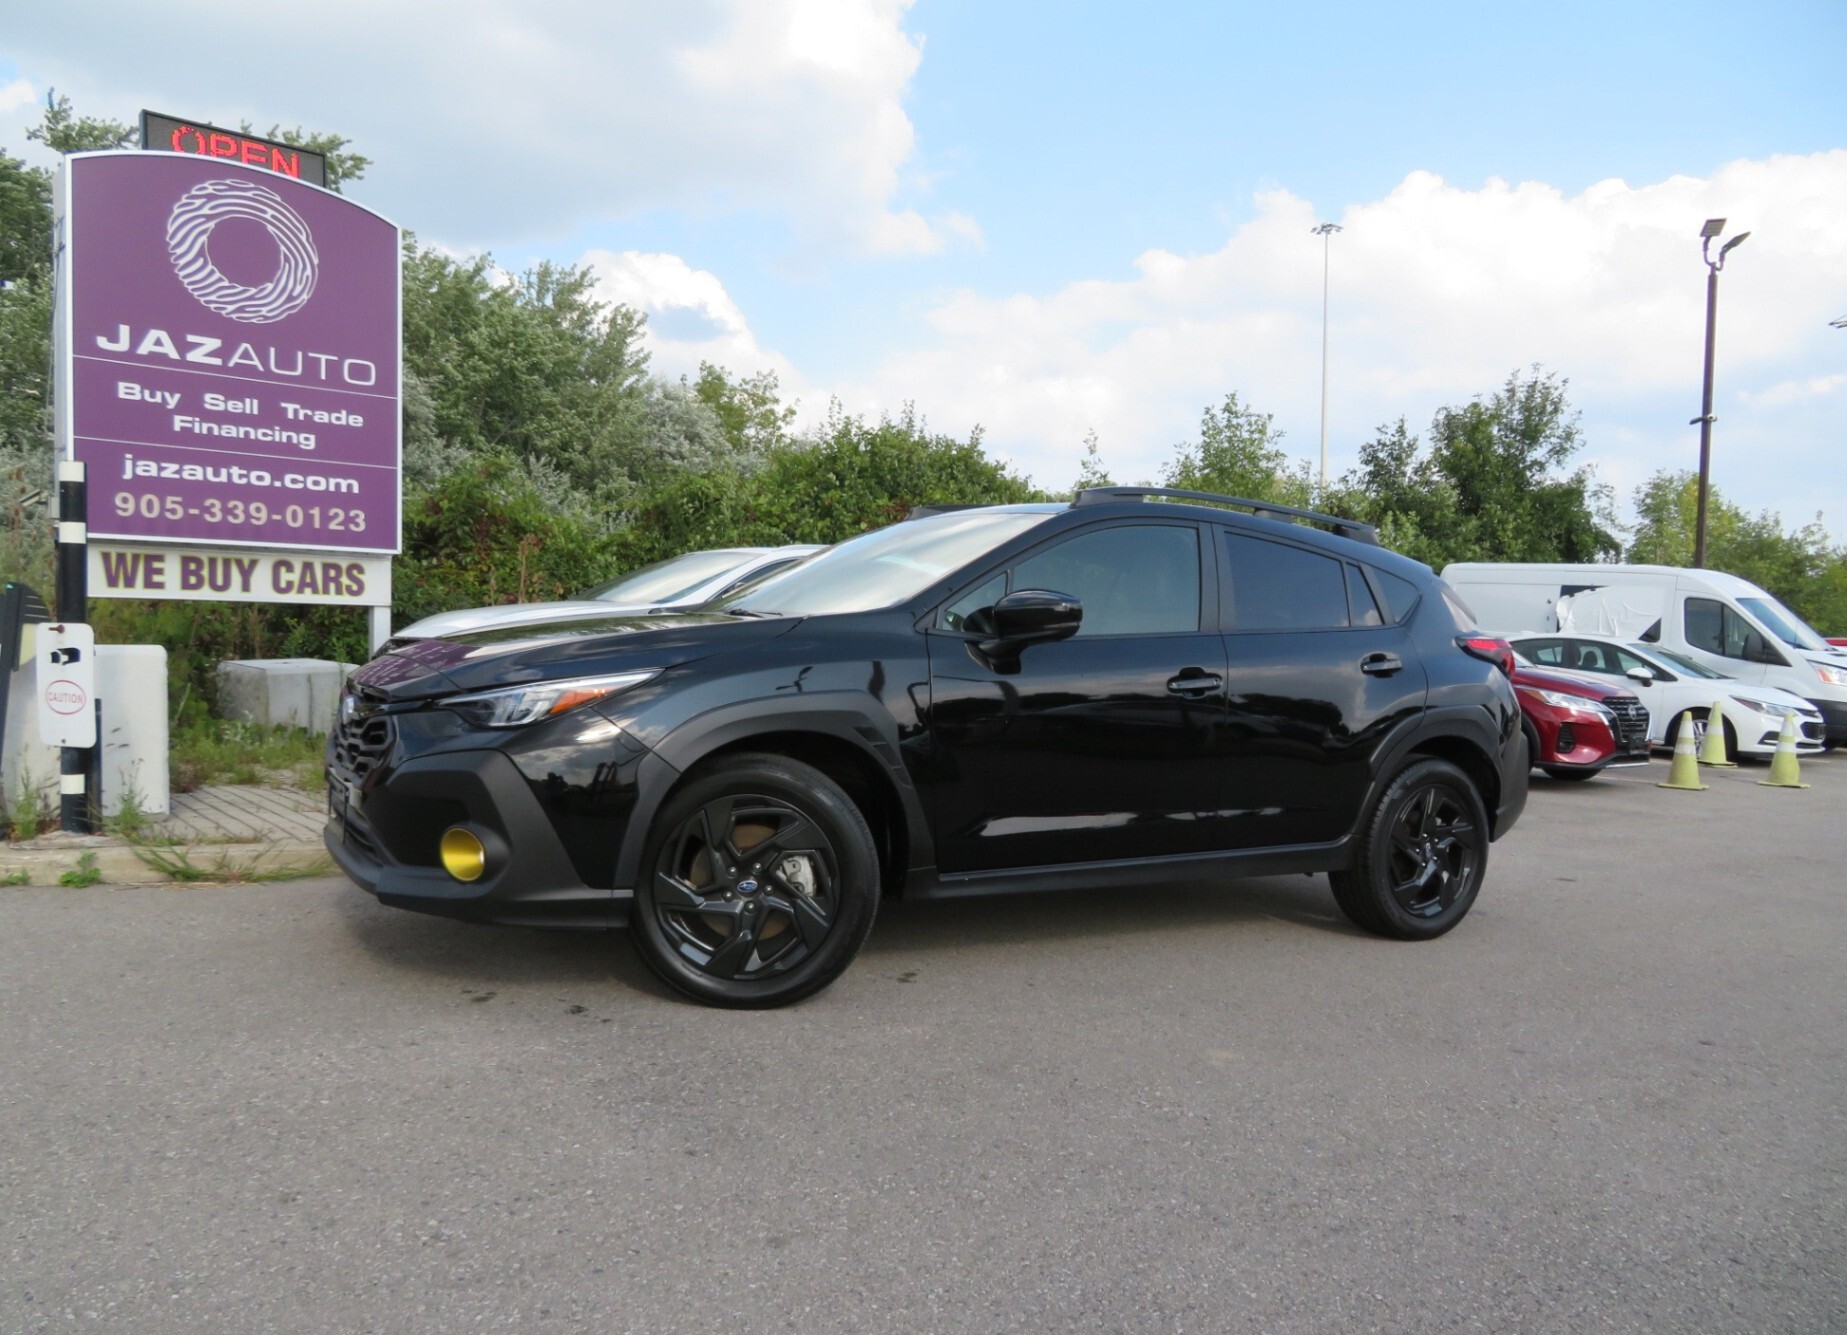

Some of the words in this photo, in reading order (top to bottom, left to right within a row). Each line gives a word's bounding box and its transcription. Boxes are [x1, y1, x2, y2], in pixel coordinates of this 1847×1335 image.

[171, 126, 299, 178] OPEN
[117, 382, 181, 409] Buy
[203, 393, 259, 415] Sell
[281, 402, 364, 427] Trade
[172, 415, 316, 449] Financing
[122, 454, 360, 494] jazauto.com
[114, 492, 367, 533] 905-339-0123
[101, 552, 166, 590] WE
[181, 556, 259, 594] BUY
[271, 559, 366, 597] CARS
[48, 691, 84, 704] CAUTION
